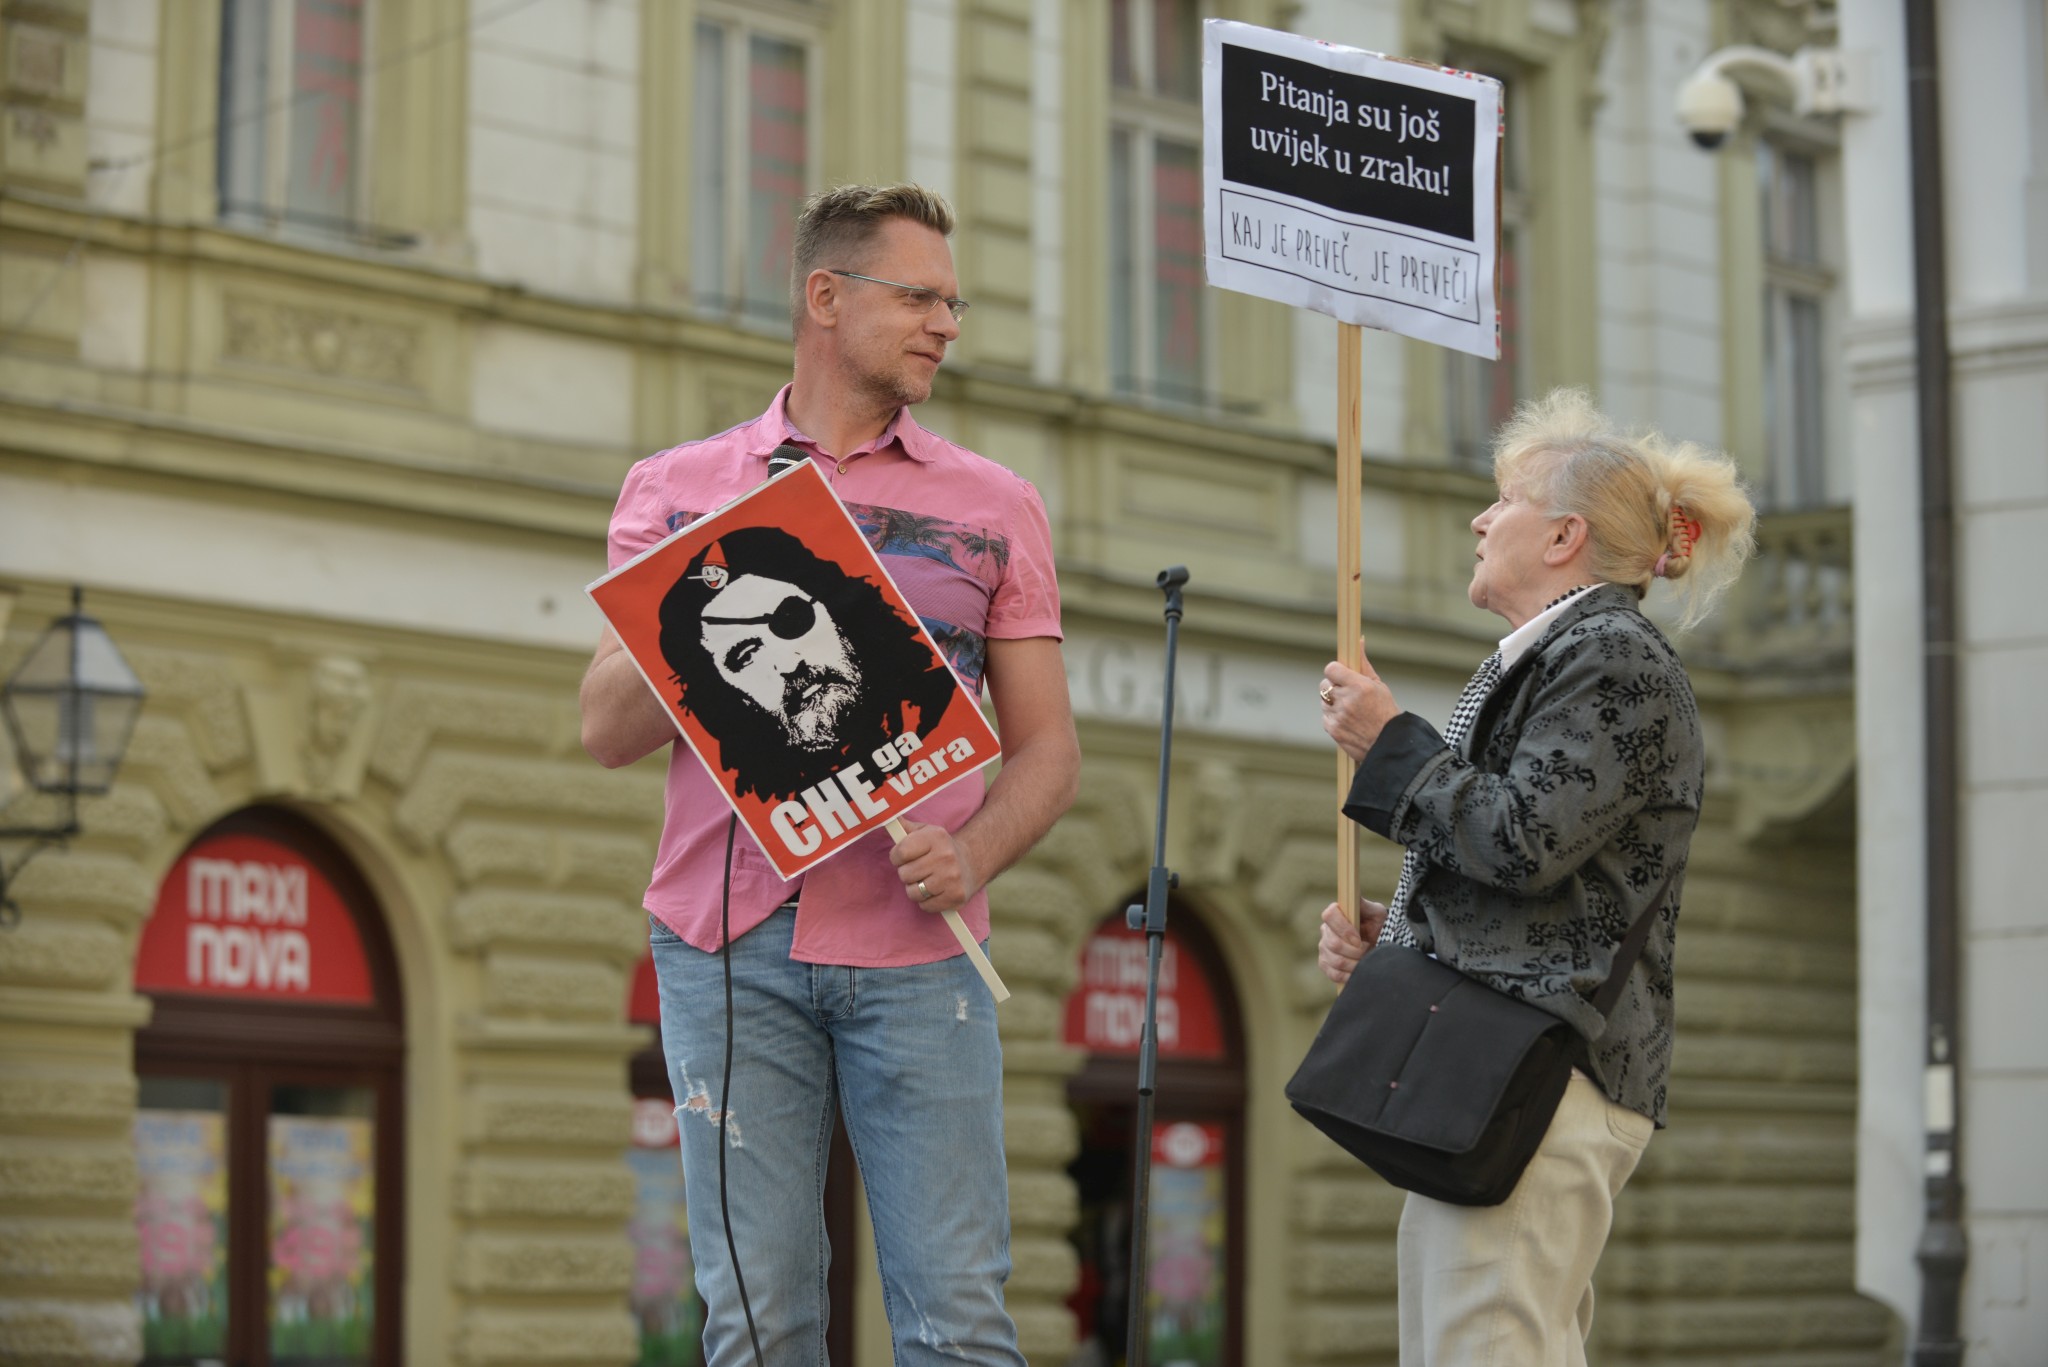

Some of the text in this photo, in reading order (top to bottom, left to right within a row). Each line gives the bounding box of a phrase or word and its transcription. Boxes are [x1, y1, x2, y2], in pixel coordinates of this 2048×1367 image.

[1260, 71, 1441, 143] Pitanja su još
[1250, 125, 1450, 197] uvijek u zraku!
[1231, 211, 1468, 305] KAJ JE PREVEČ, JE PREVEČ!
[871, 731, 924, 773] ga
[770, 736, 976, 857] CHE vara
[187, 858, 308, 926] MAXI
[187, 923, 310, 991] NOVA
